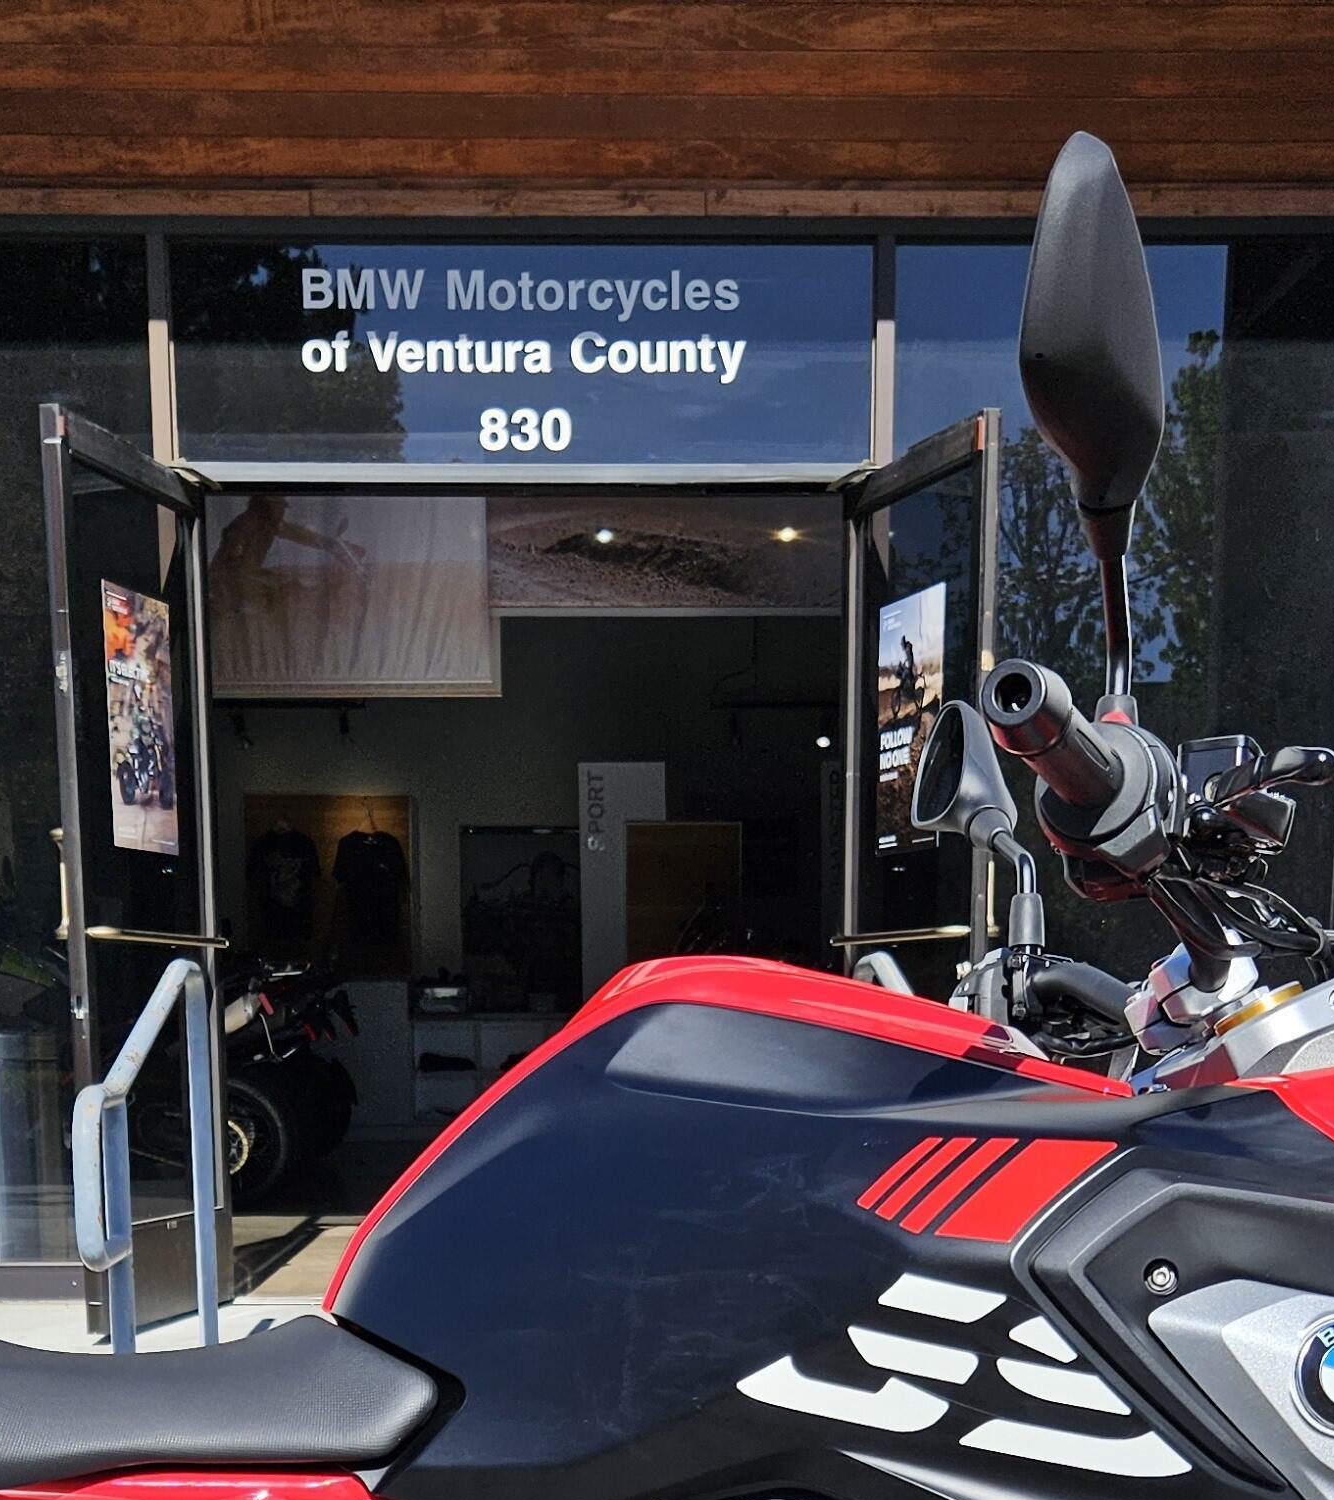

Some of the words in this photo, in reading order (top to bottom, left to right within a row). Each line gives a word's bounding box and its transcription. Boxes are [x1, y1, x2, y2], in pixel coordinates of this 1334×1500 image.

[301, 268, 425, 310] BMW
[446, 269, 741, 322] Motorcycles
[301, 331, 351, 373] of
[366, 331, 552, 374] Ventura
[570, 331, 747, 384] County
[478, 407, 573, 452] 830
[879, 725, 915, 752] FOLLOW
[586, 769, 605, 852] SPORT
